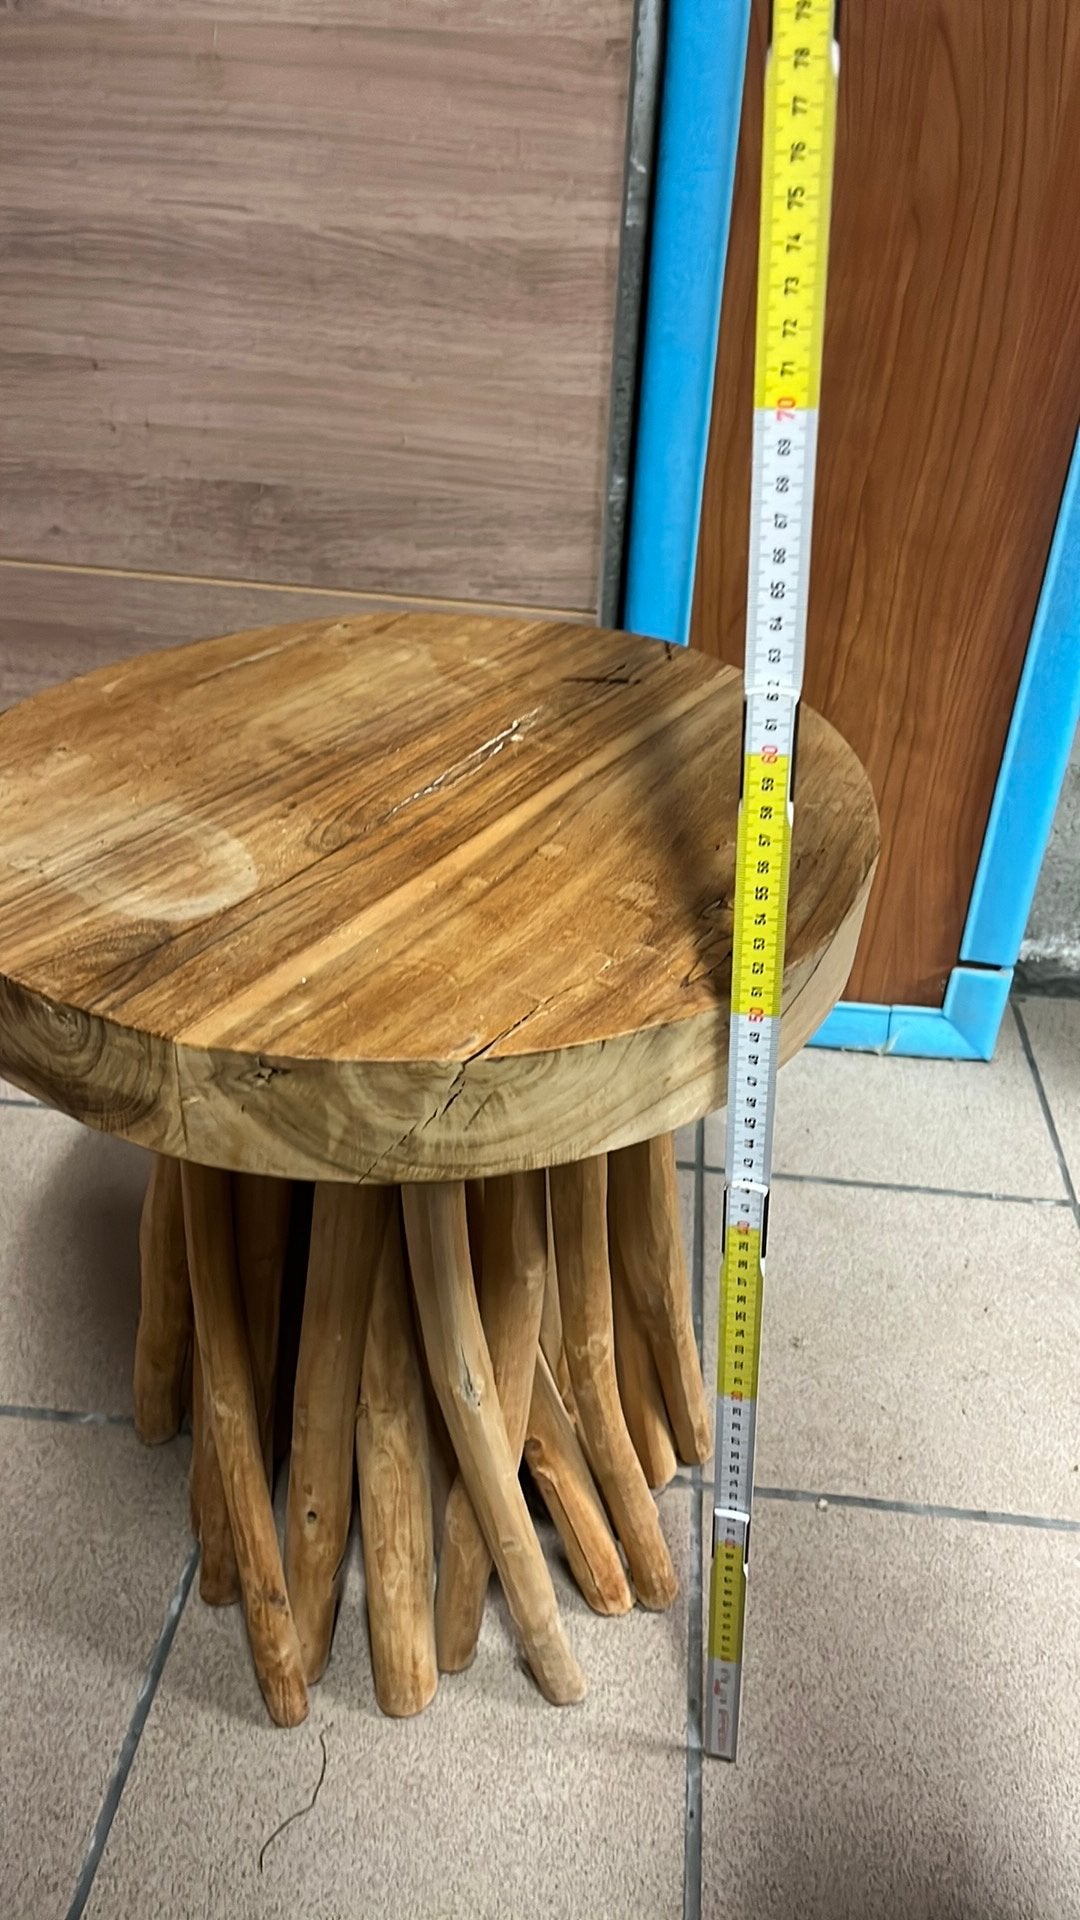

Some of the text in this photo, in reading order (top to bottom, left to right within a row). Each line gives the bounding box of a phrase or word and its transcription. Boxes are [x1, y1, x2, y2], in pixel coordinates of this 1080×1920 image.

[794, 47, 810, 69] 78
[792, 96, 807, 116] 77
[791, 141, 806, 163] 76
[787, 186, 805, 210] 75
[786, 233, 801, 253] 74
[784, 276, 799, 295] 73
[782, 319, 797, 338] 72
[780, 361, 795, 377] 71
[776, 396, 796, 422] 70
[777, 438, 791, 456] 69
[775, 476, 790, 493] 68
[774, 513, 788, 529] 67
[772, 547, 786, 565] 66
[770, 581, 785, 599] 65
[769, 616, 782, 631] 64
[768, 648, 781, 664] 63
[764, 718, 777, 731] 61
[761, 745, 778, 764] 60
[761, 777, 774, 791] 59
[759, 805, 772, 819] 58
[758, 834, 771, 847] 57
[756, 860, 769, 874] 56
[754, 886, 769, 901] 55
[754, 913, 766, 925] 54
[753, 938, 765, 950] 53
[752, 962, 764, 974] 52
[748, 1006, 764, 1022] 50
